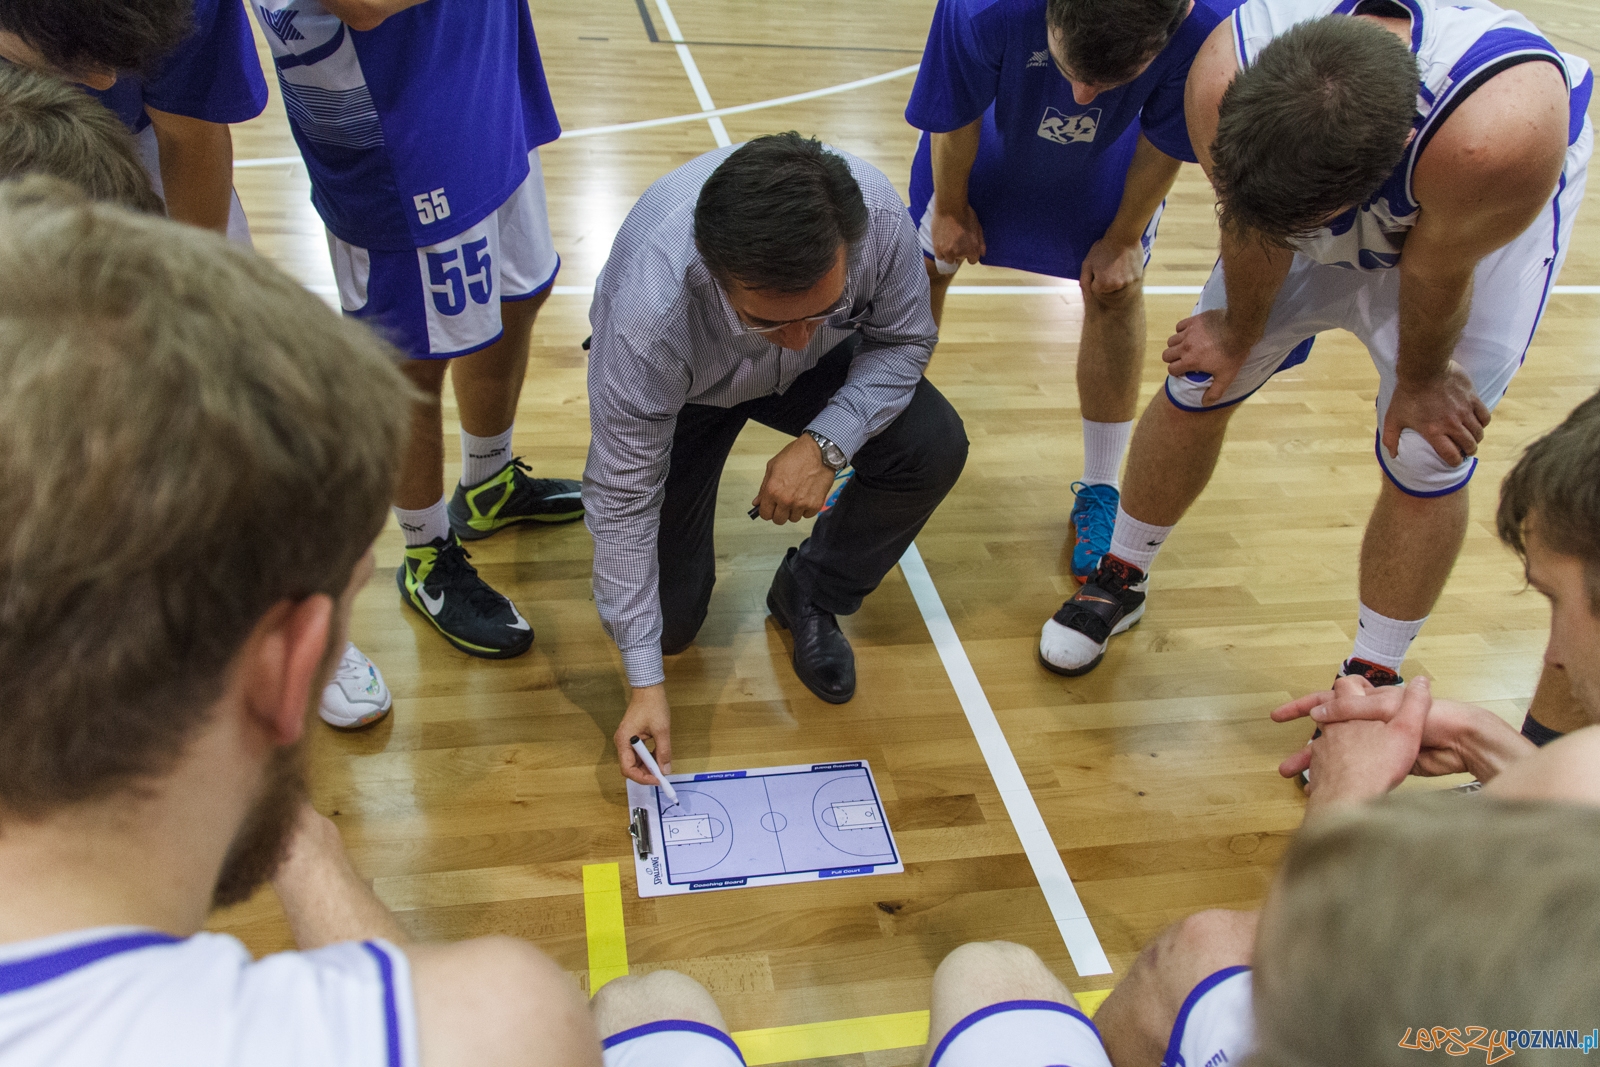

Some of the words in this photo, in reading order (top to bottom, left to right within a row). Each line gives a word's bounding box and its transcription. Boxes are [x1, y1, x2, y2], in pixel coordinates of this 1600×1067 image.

[413, 187, 451, 225] 55
[426, 236, 493, 317] 55
[651, 856, 662, 885] SPALDING
